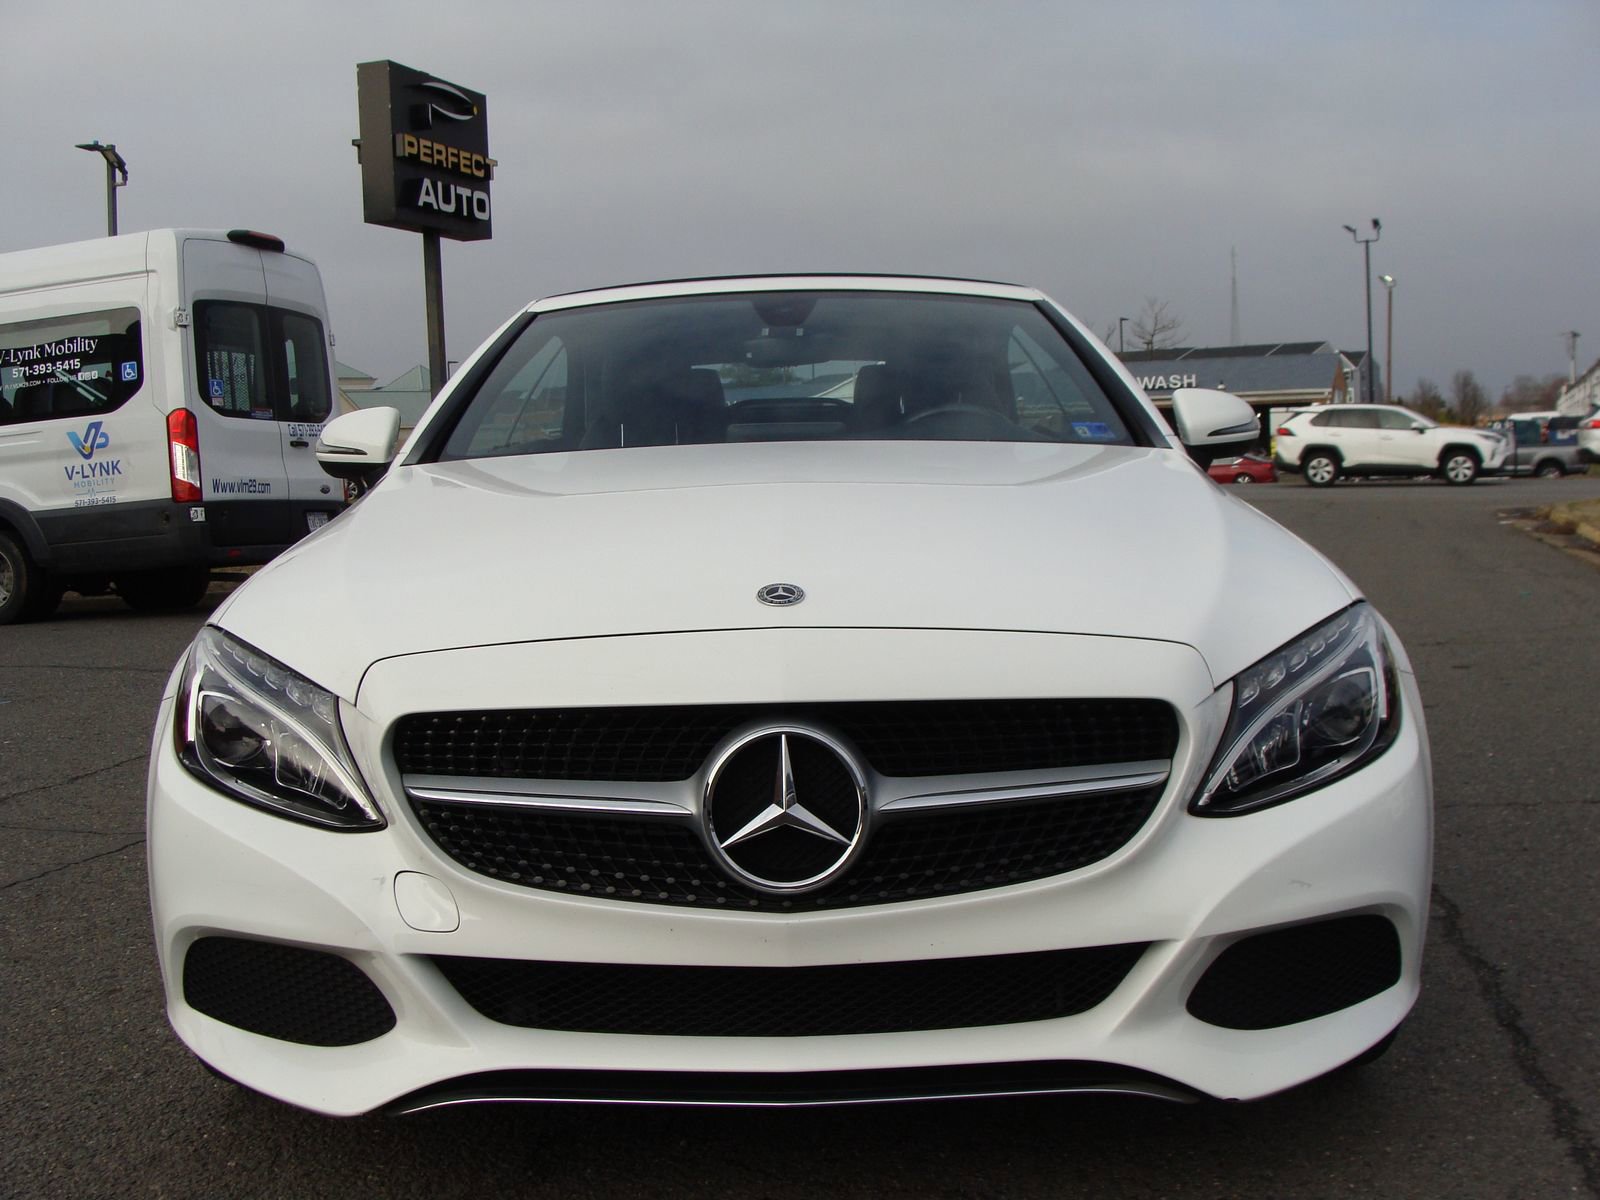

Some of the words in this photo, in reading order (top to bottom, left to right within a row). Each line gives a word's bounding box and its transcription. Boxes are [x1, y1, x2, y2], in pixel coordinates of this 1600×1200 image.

[402, 133, 498, 181] PERFECT
[417, 177, 491, 221] AUTO
[44, 337, 98, 357] Mobility
[12, 358, 81, 378] 571-393-5415
[47, 376, 69, 385] FOLLO
[1136, 374, 1197, 390] WASH
[64, 459, 122, 481] V-LYNK
[73, 477, 115, 488] MOBILITY
[212, 478, 271, 494] Www.vlm29.com
[75, 496, 116, 508] 571-393-5415
